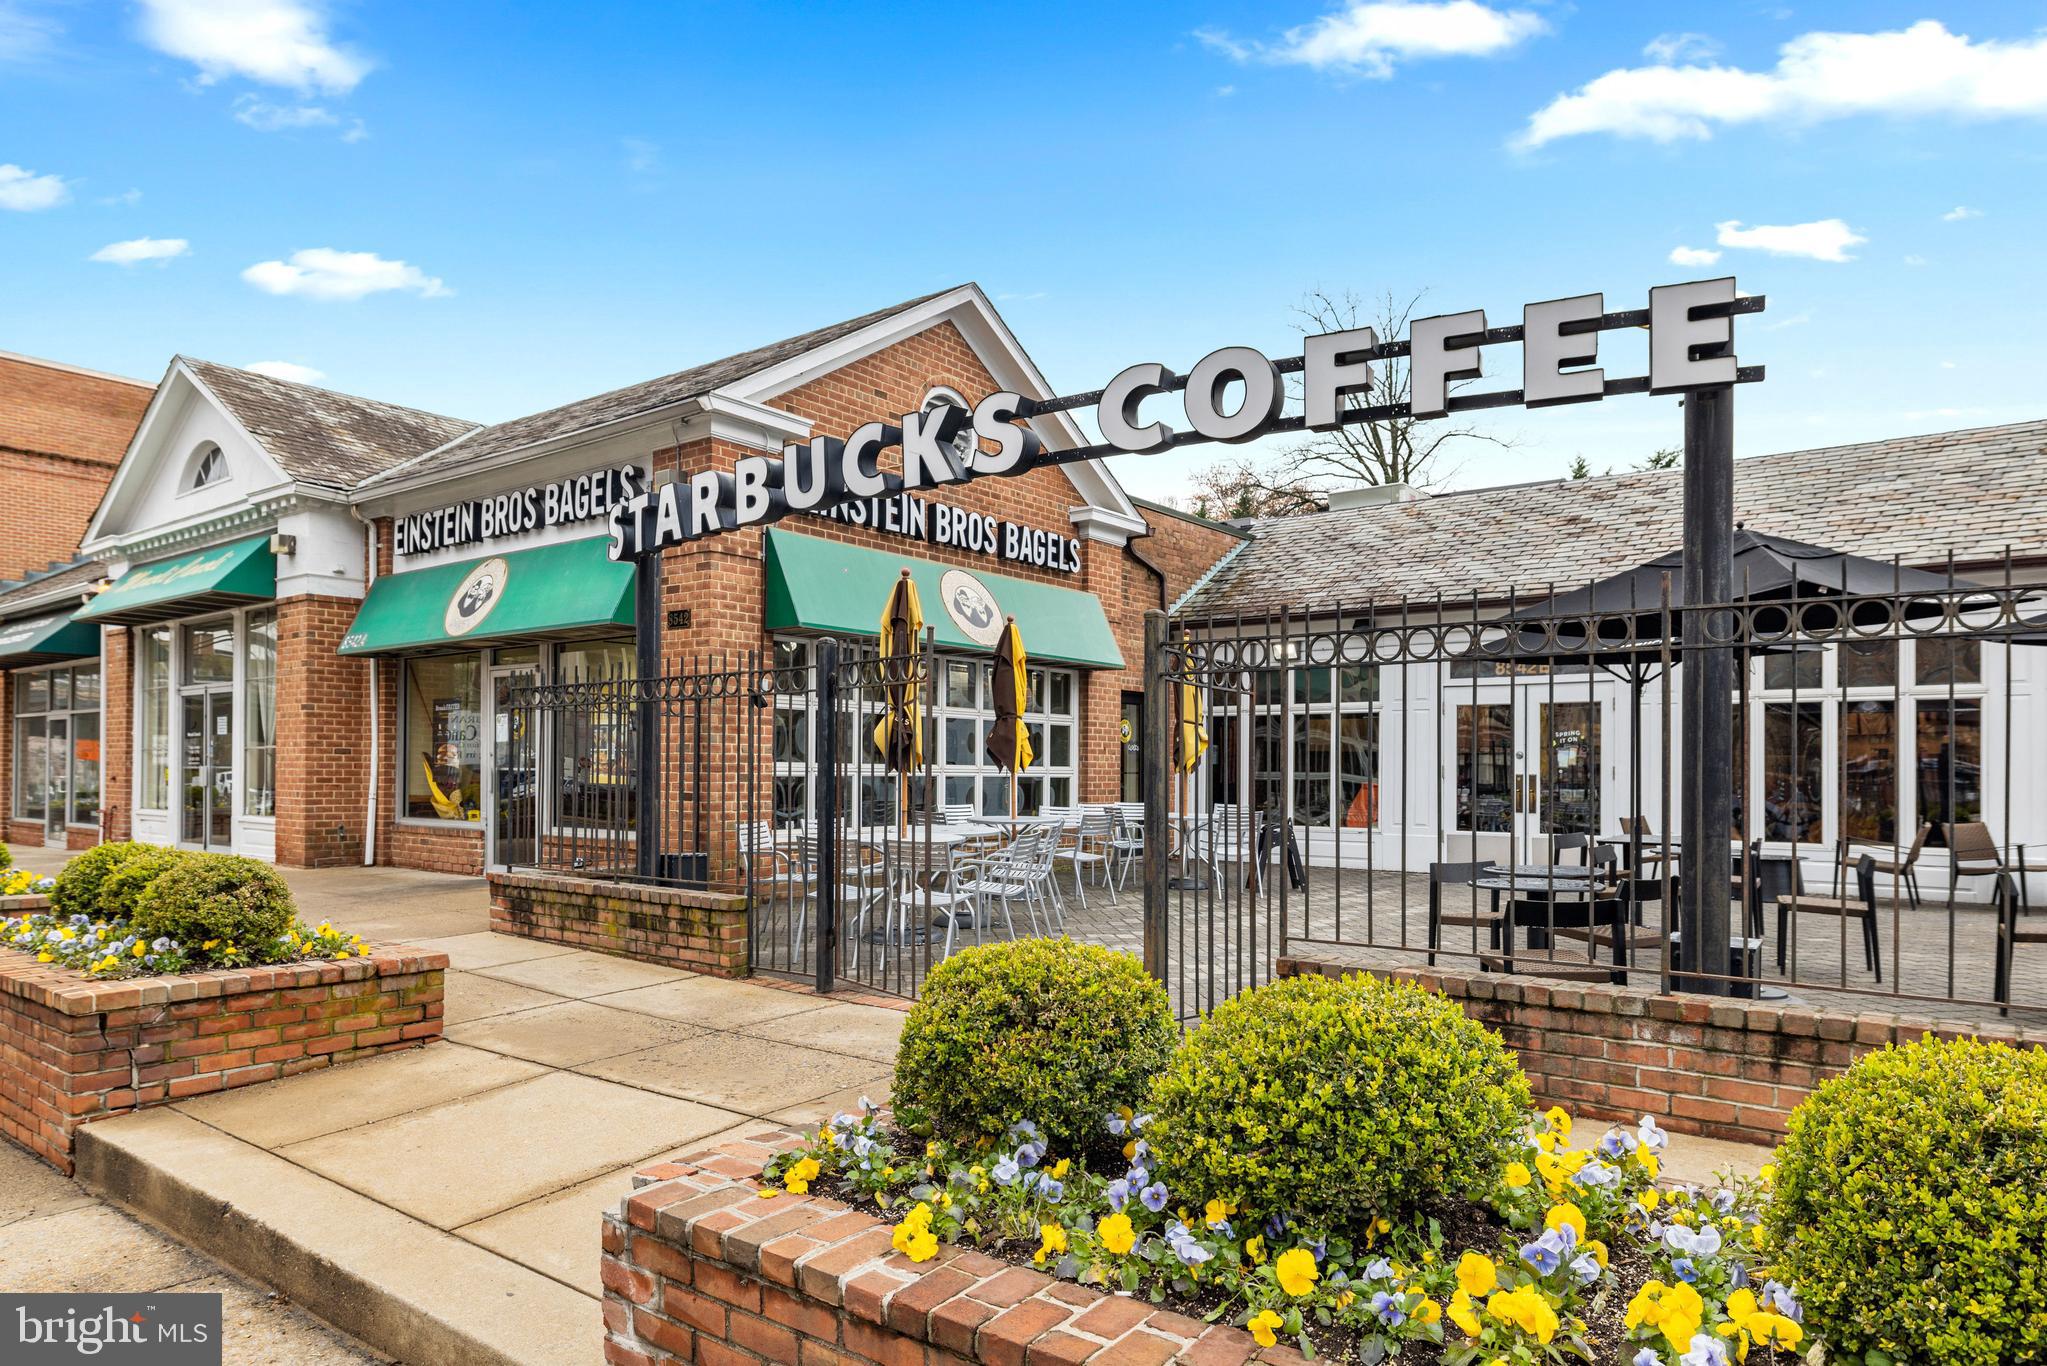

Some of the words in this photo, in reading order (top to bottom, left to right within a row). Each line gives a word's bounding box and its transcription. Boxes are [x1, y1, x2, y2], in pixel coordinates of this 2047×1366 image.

[608, 391, 1030, 561] STARBUCKS
[1097, 276, 1738, 453] COFFEE
[394, 501, 474, 556] EINSTEIN
[481, 486, 537, 538] BROS
[545, 464, 635, 525] BAGELS
[809, 493, 926, 540] STEIN
[935, 502, 997, 554] BROS
[1005, 521, 1081, 573] BAGELS
